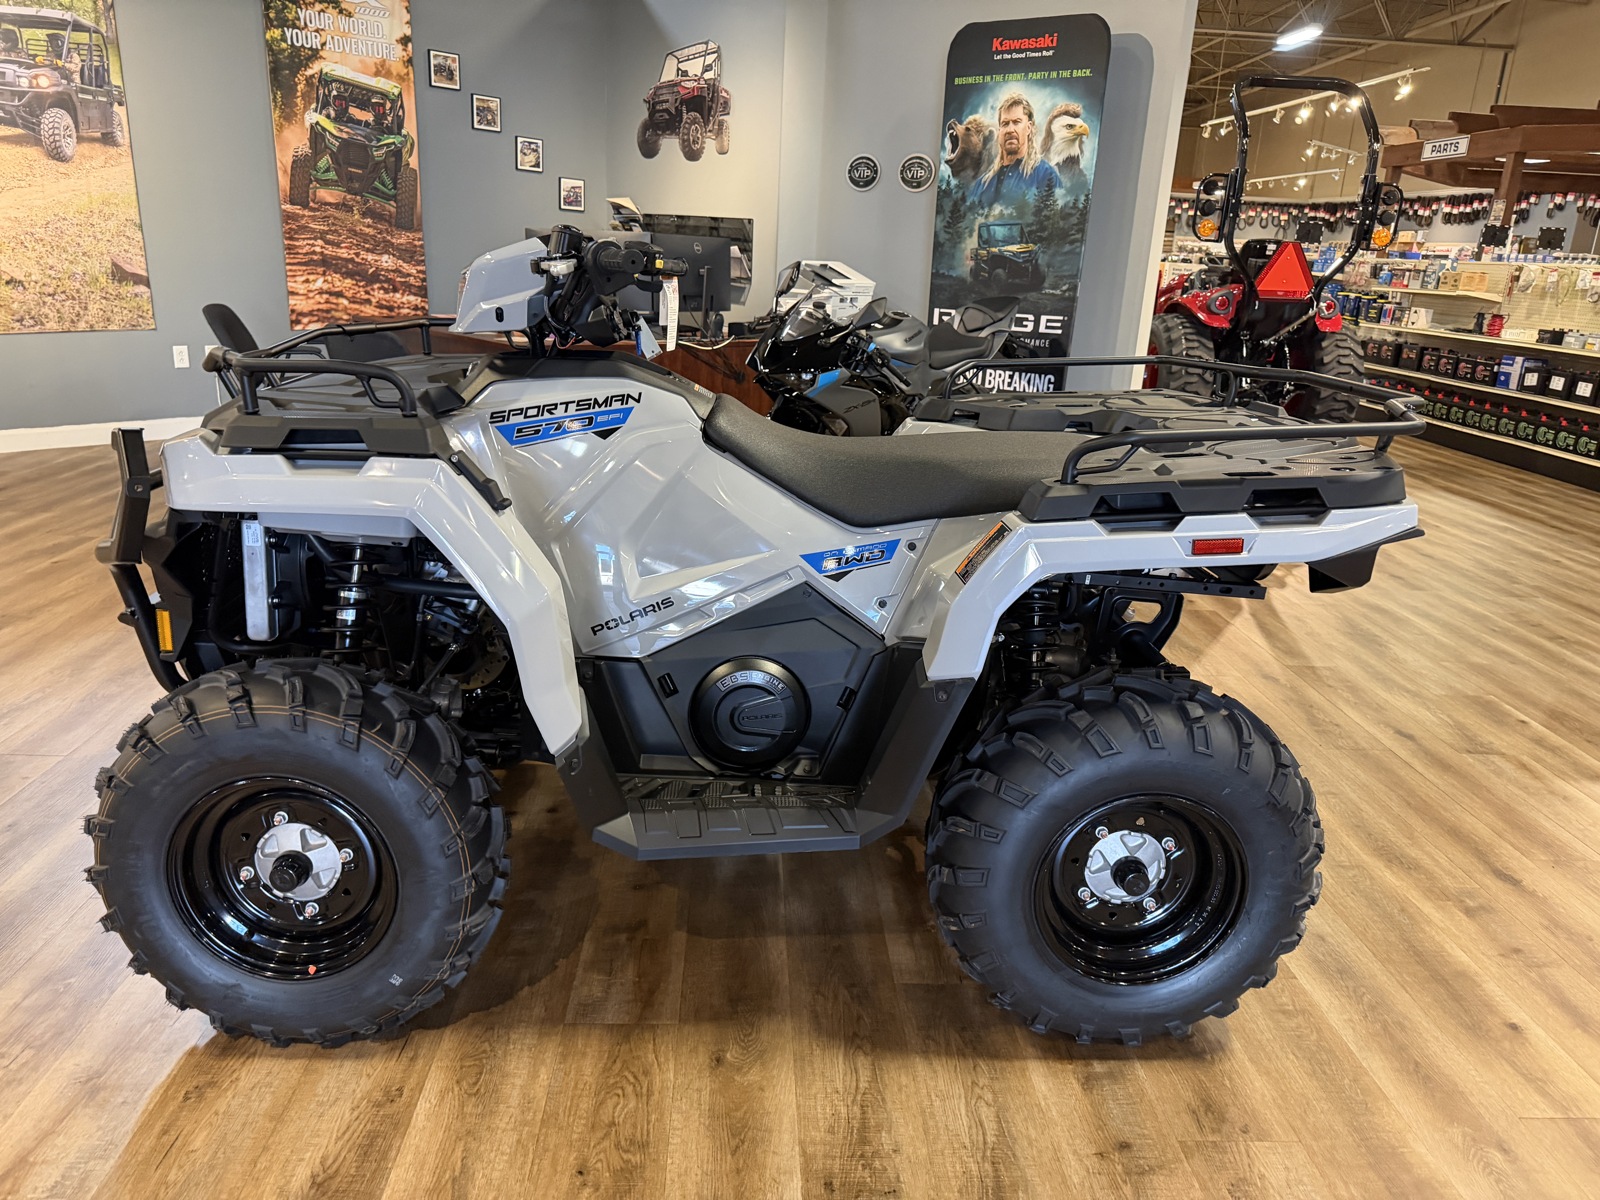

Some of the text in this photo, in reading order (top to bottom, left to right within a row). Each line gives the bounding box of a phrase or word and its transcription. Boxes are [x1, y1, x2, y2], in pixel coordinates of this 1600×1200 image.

[355, 6, 390, 18] 1000
[297, 8, 387, 38] YOUR WORLD.
[284, 27, 400, 61] YOUR ADVENTURE.
[992, 33, 1058, 51] Kawasaki
[954, 69, 1093, 85] BUSINESS IN THE FRONT. PARTY IN THE BACK.
[1430, 141, 1460, 155] PARTS
[854, 169, 871, 178] VIP
[907, 169, 925, 178] VIP
[984, 368, 1055, 393] BREAKING
[489, 392, 642, 424] SPORTSMAN
[513, 412, 623, 440] 570 EFI
[590, 596, 675, 637] POLARIS
[720, 672, 749, 689] EBS
[741, 713, 783, 721] POLARIS
